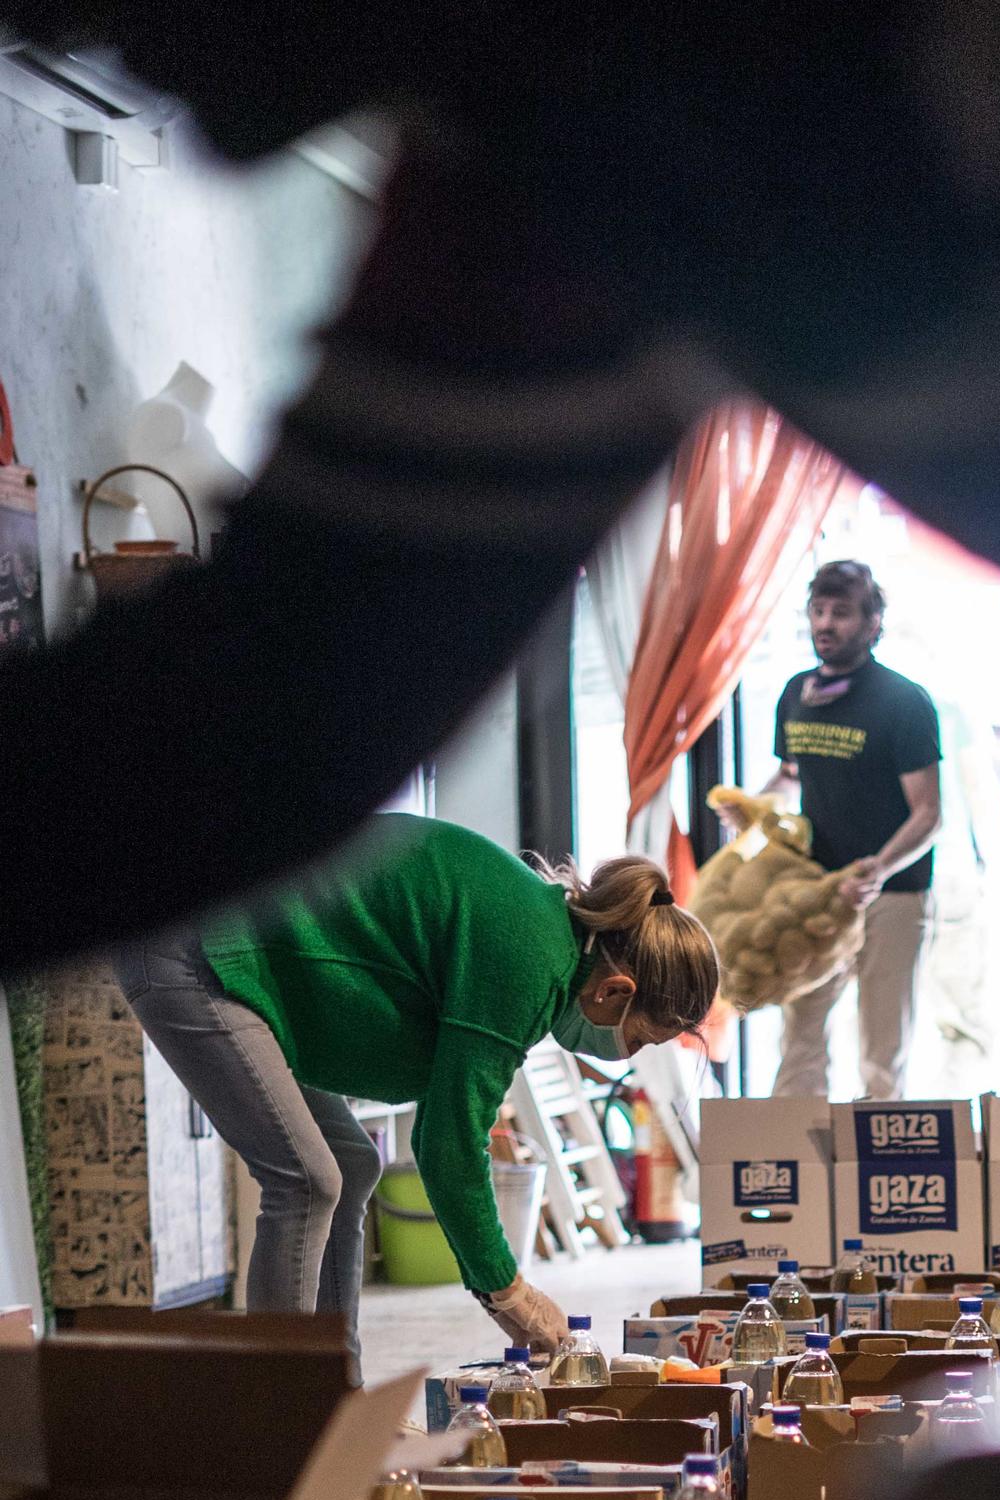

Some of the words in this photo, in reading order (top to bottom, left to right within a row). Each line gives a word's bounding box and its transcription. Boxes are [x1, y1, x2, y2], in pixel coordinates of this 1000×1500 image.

[870, 1113, 939, 1147] gaza
[741, 1167, 791, 1194] gaza
[869, 1175, 946, 1215] gaza
